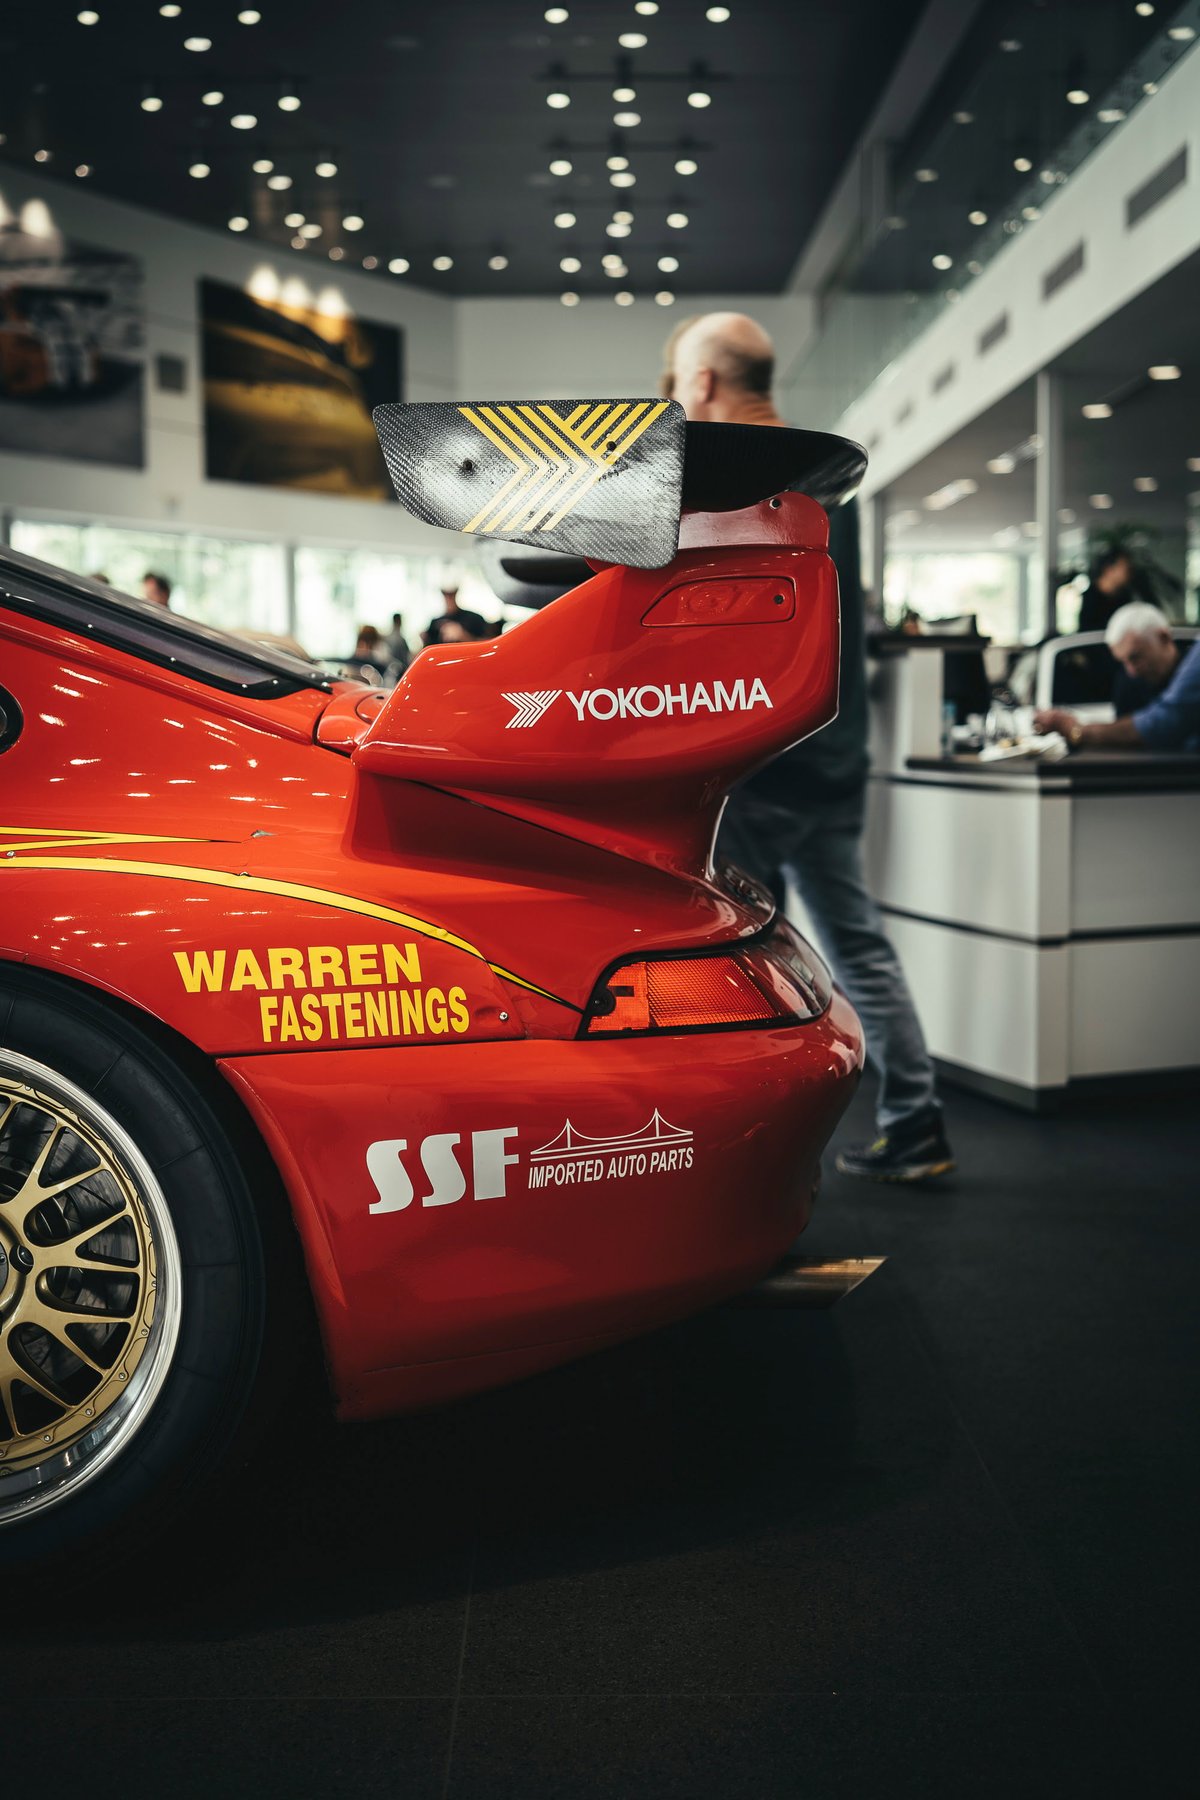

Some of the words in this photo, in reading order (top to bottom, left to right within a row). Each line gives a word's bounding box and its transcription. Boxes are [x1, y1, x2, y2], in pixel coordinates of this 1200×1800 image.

[565, 678, 773, 721] YOKOHAMA
[173, 943, 422, 993] WARREN
[259, 986, 470, 1042] FASTENINGS
[366, 1127, 520, 1215] SSF
[528, 1159, 604, 1189] IMPORTED
[606, 1150, 646, 1179] AUTO
[650, 1147, 694, 1173] PARTS
